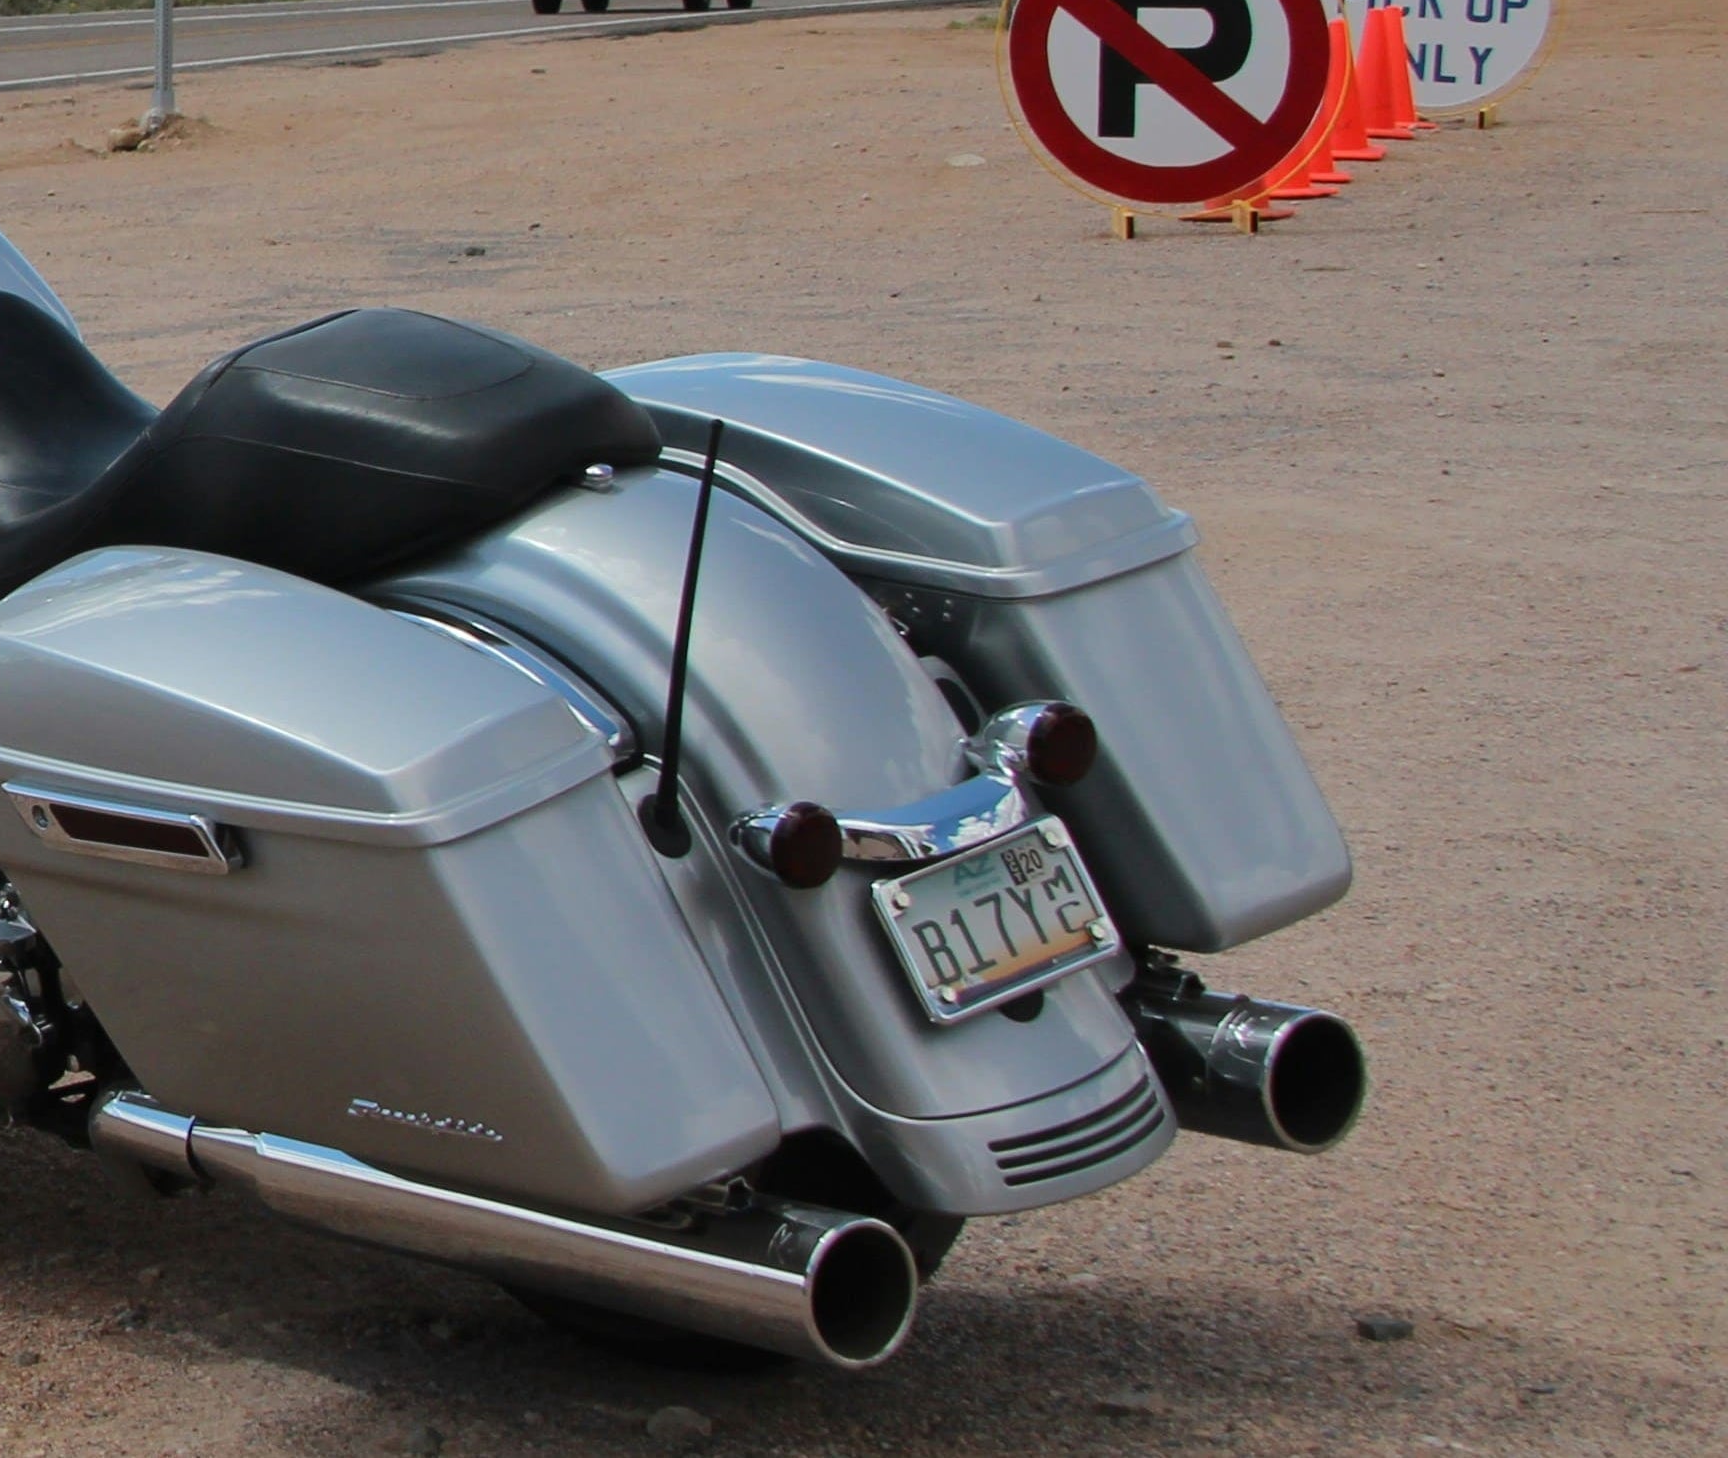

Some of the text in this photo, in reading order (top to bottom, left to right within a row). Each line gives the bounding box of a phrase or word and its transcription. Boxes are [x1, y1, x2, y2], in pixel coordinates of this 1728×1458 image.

[1404, 43, 1494, 85] NLY
[1019, 848, 1043, 874] 20
[912, 887, 1049, 992] B17Y
